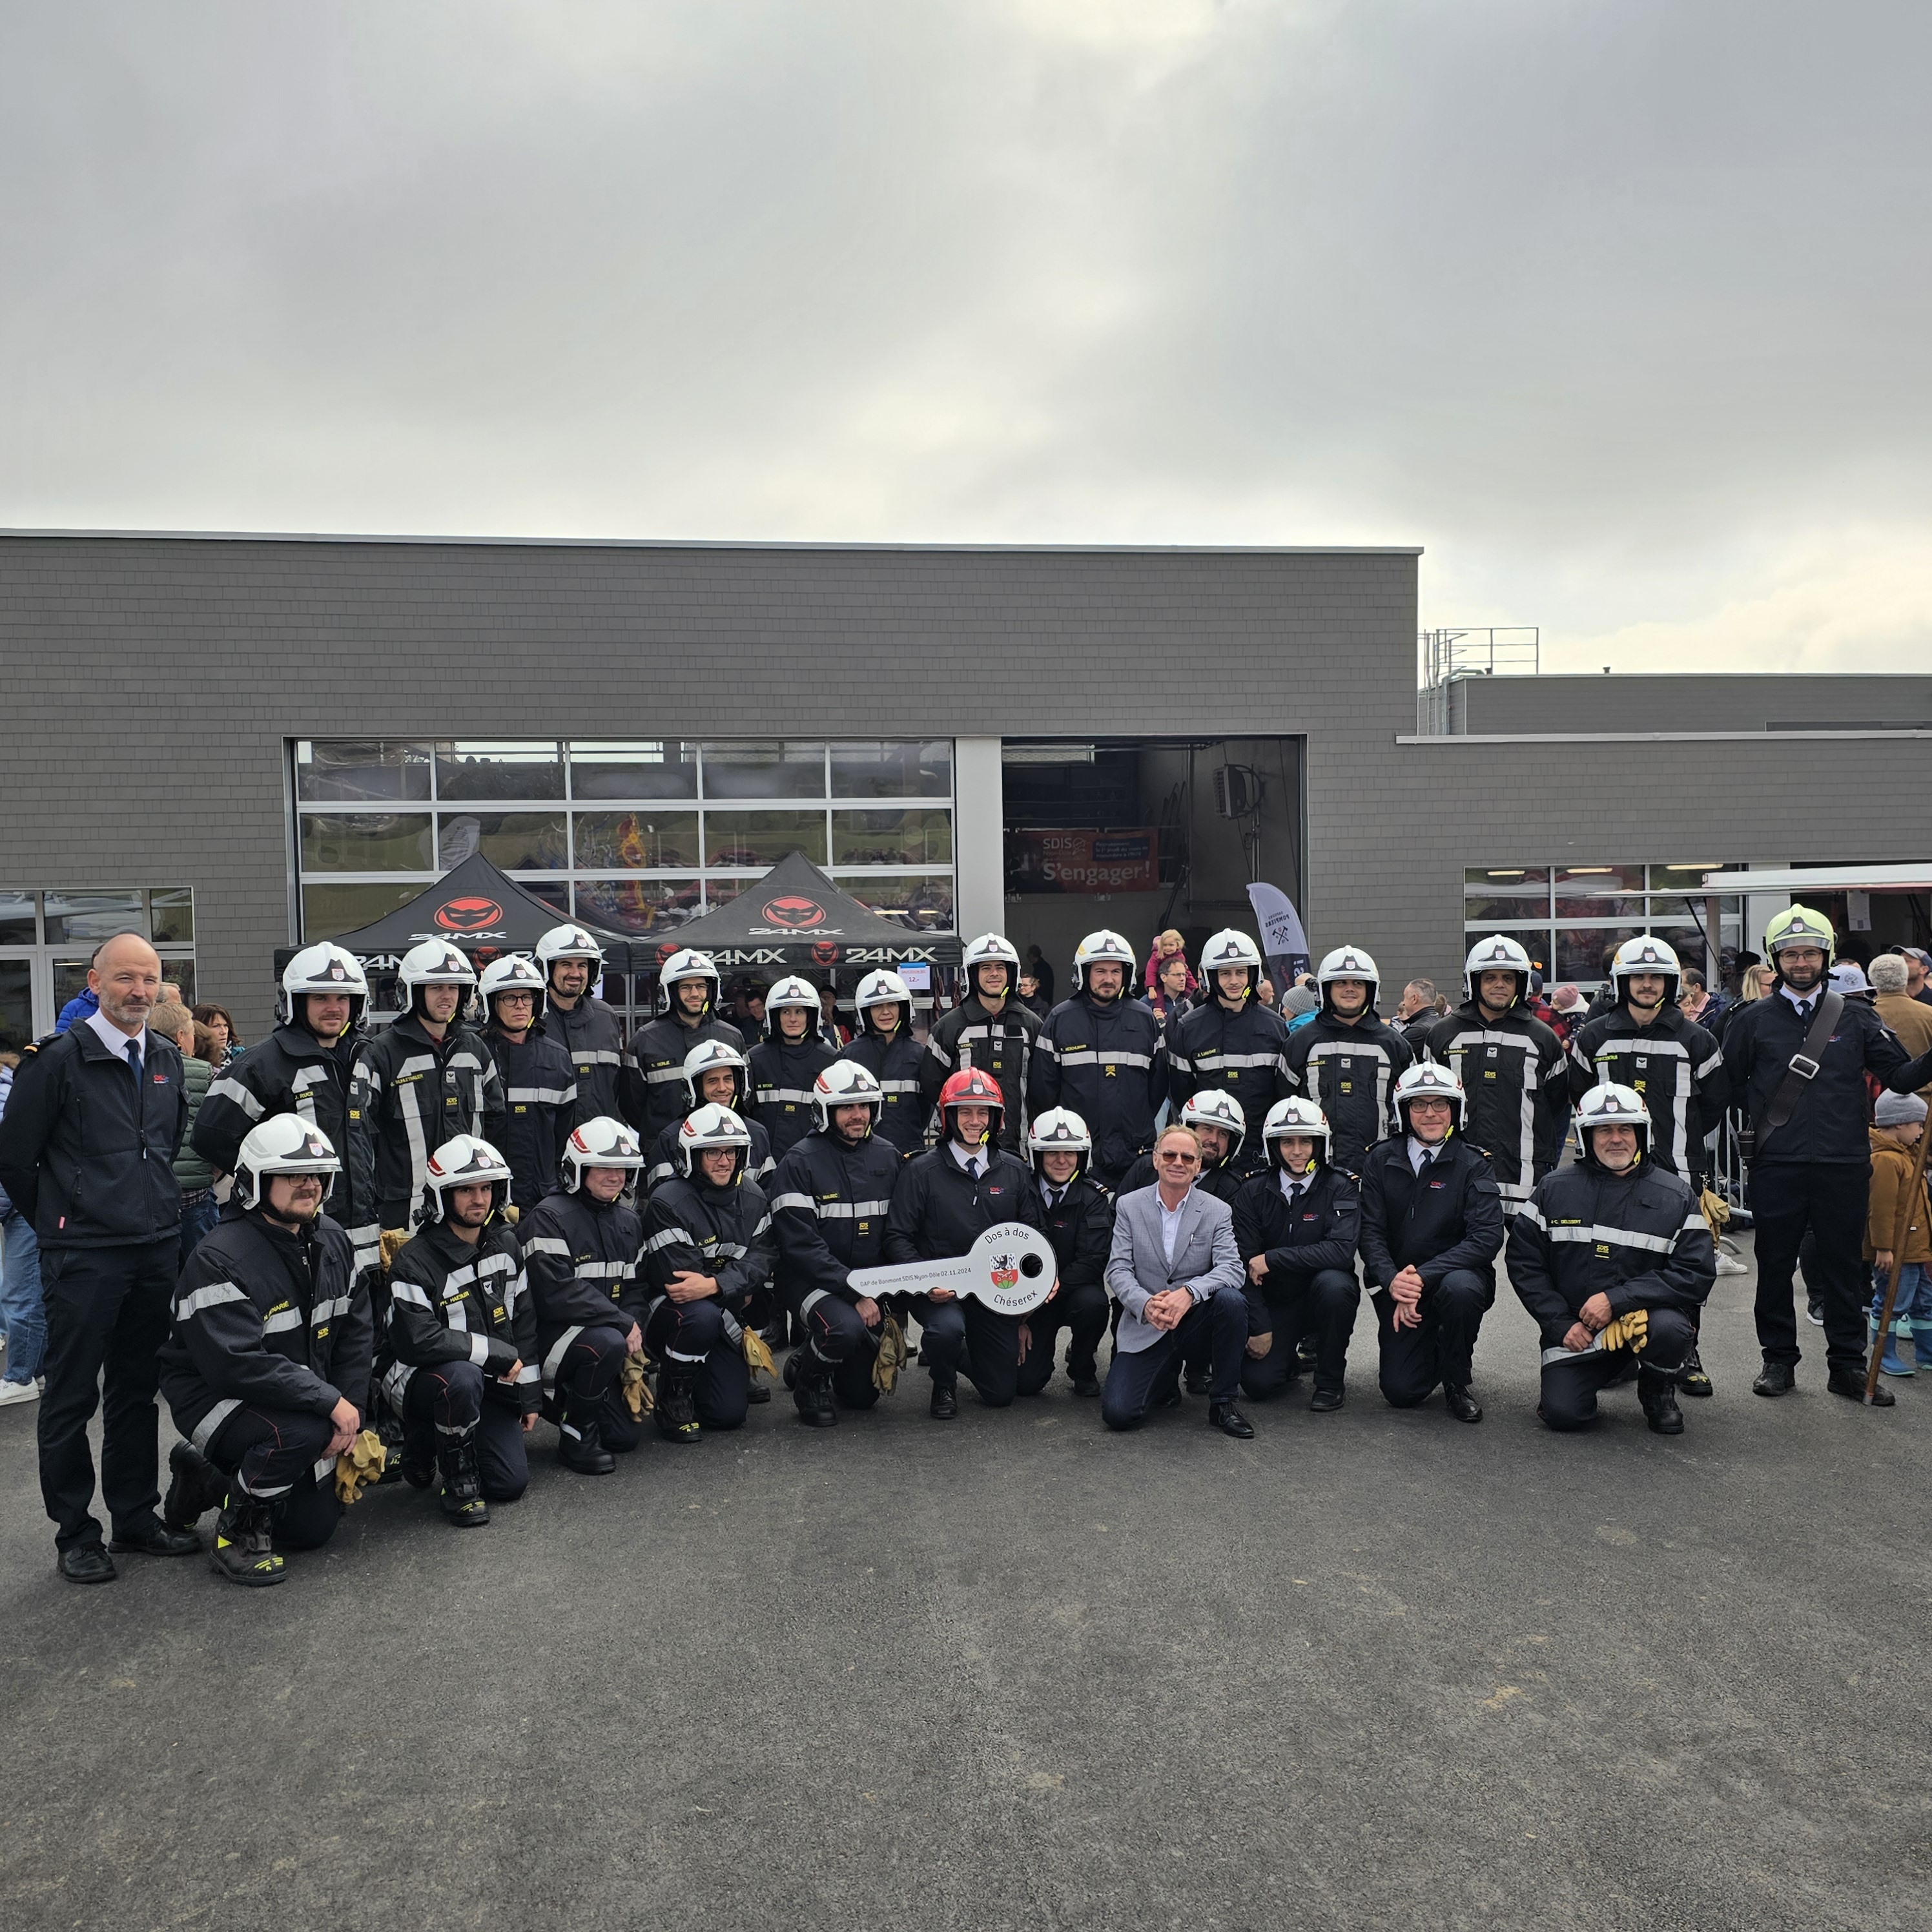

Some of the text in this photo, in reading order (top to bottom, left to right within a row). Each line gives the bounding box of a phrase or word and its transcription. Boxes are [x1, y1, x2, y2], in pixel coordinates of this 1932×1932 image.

[1043, 838, 1073, 849] SDIS
[407, 931, 508, 941] 24MX
[748, 927, 845, 936] 24MX
[845, 947, 938, 963] 24MX
[985, 1227, 1029, 1244] Dos à dos
[879, 1277, 902, 1285] Bonmont
[914, 1271, 940, 1282] Nyon-Dôle
[941, 1268, 971, 1277] 02.11.2024
[994, 1290, 1038, 1306] Chéserex
